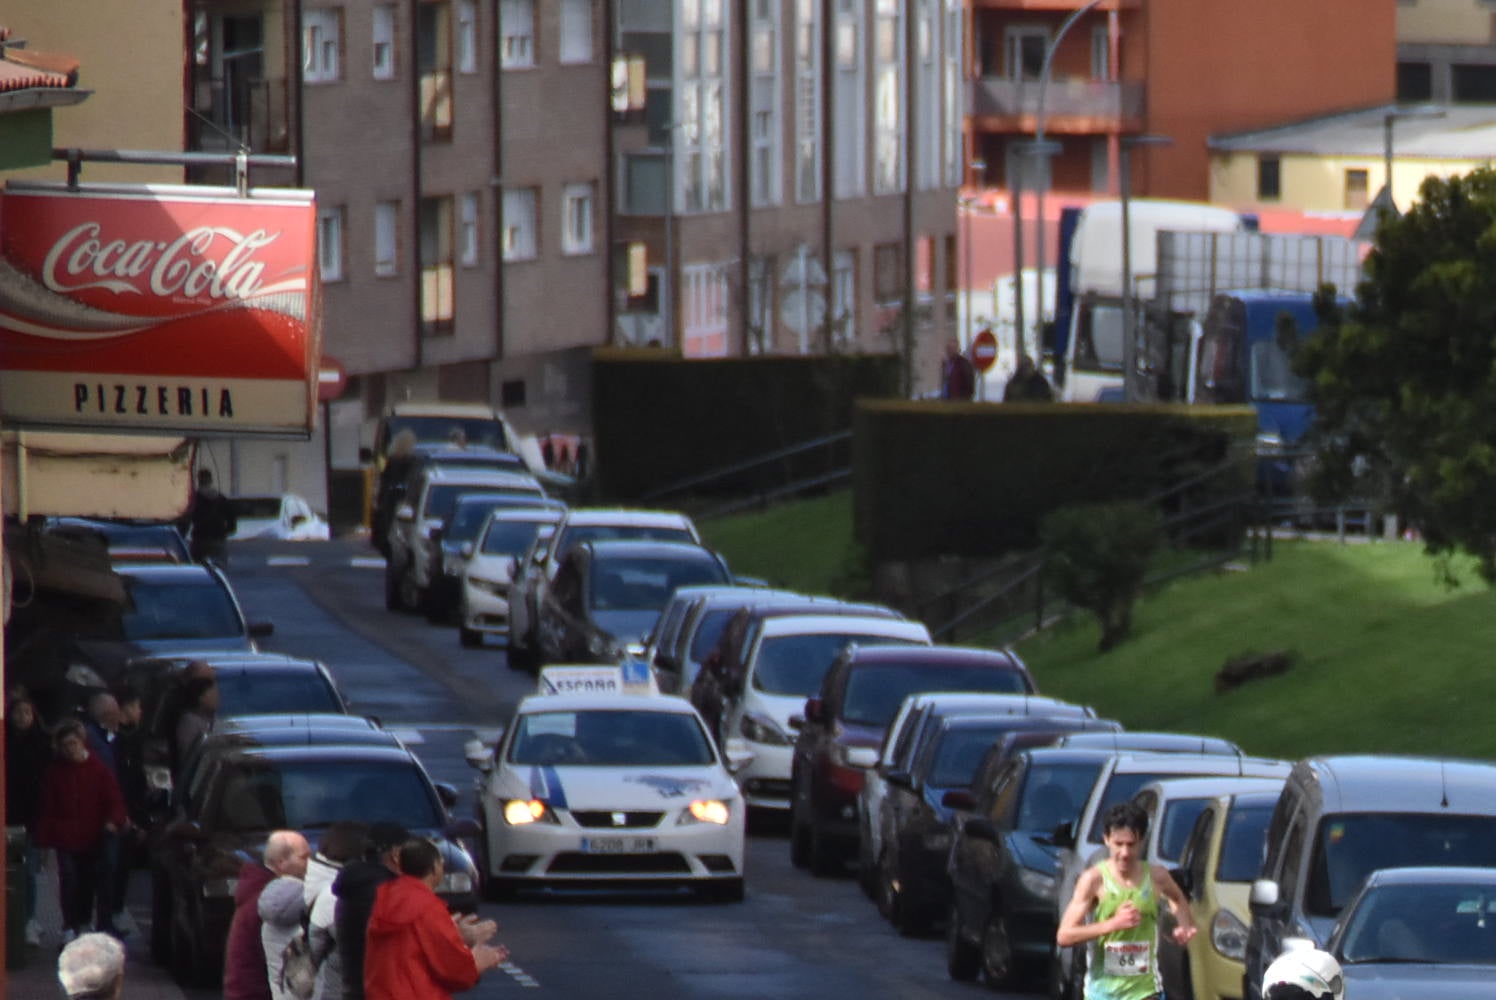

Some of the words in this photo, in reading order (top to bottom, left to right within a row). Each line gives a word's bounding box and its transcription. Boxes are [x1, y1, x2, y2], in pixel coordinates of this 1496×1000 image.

[43, 222, 281, 299] Coca-Cola
[75, 384, 233, 417] PIZZERIA
[1119, 953, 1135, 967] 66
